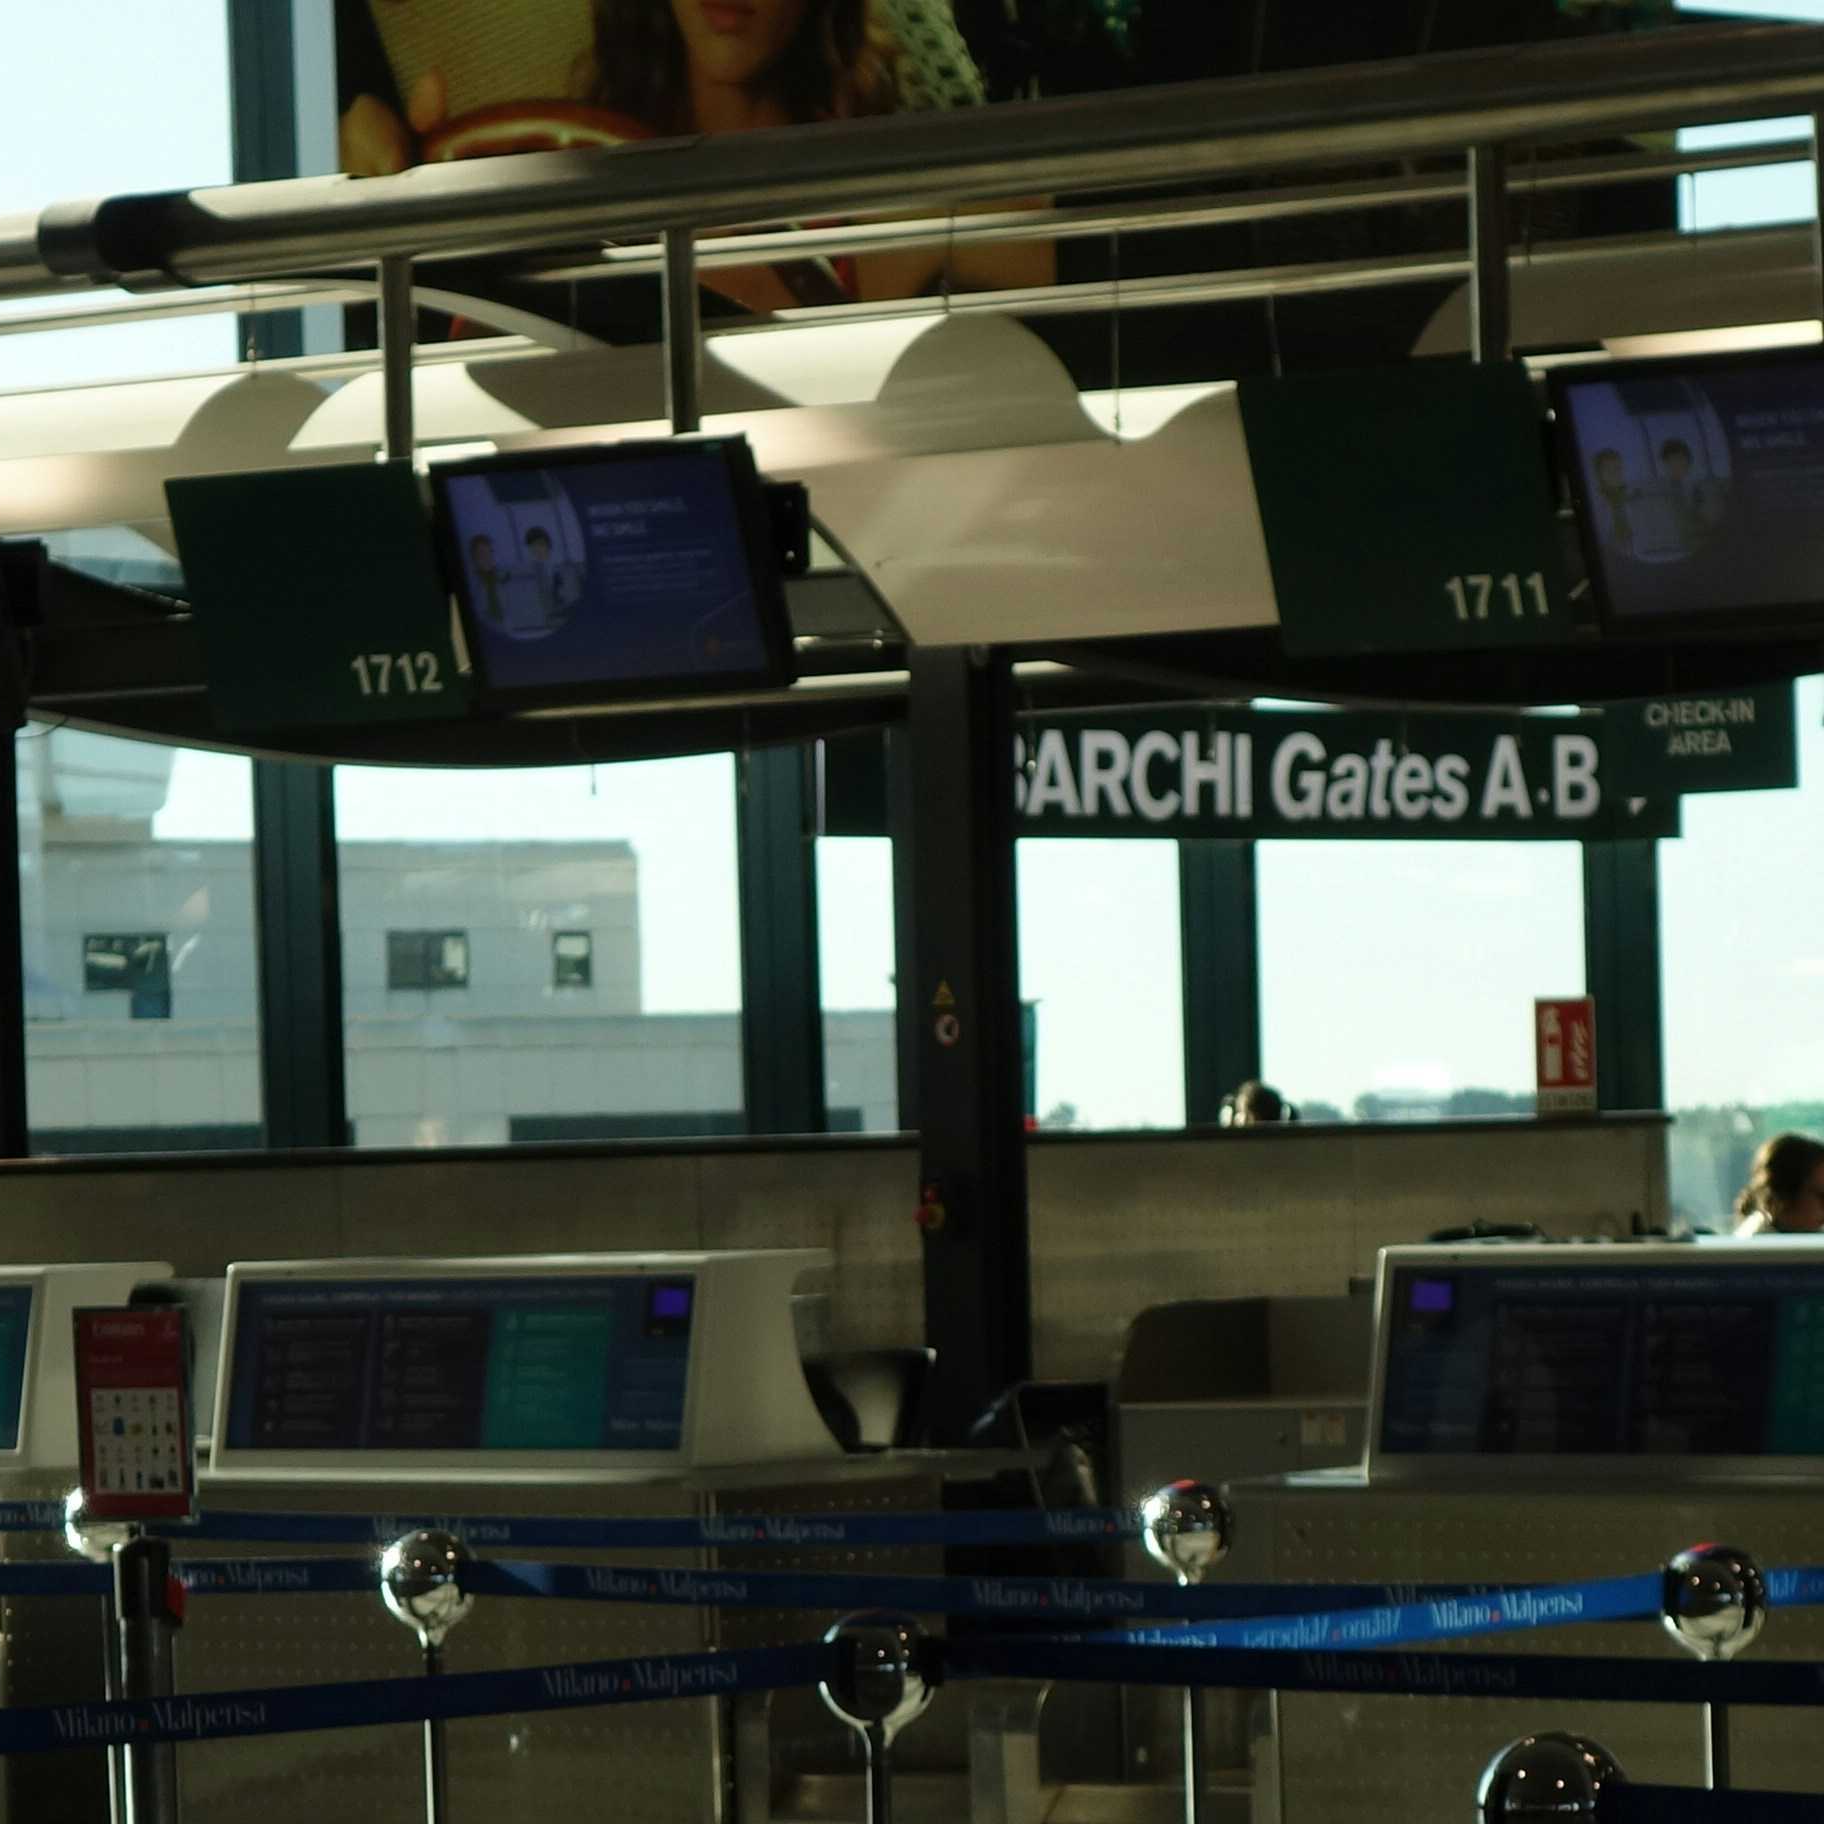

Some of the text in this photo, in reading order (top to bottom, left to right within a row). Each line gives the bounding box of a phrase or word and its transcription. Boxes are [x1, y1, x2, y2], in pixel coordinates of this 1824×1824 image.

[1445, 571, 1550, 621] 1711
[351, 650, 444, 695] 1712
[1644, 698, 1756, 728] CHECK-IN
[1666, 730, 1733, 756] AREA
[1269, 728, 1473, 822] Gates
[698, 1517, 847, 1544] Milano Malpensa
[1044, 1509, 1105, 1534] Milano
[224, 1564, 311, 1594] Malpensa
[585, 1568, 749, 1601] Milano Malpensa
[971, 1579, 1146, 1614] Milano Malpensa
[1430, 1592, 1584, 1632] Milano Malpensa
[541, 1657, 738, 1699] Milano Malpensa
[1298, 1653, 1518, 1692] Milano Malpensa
[50, 1697, 268, 1739] Milano Malpensa
